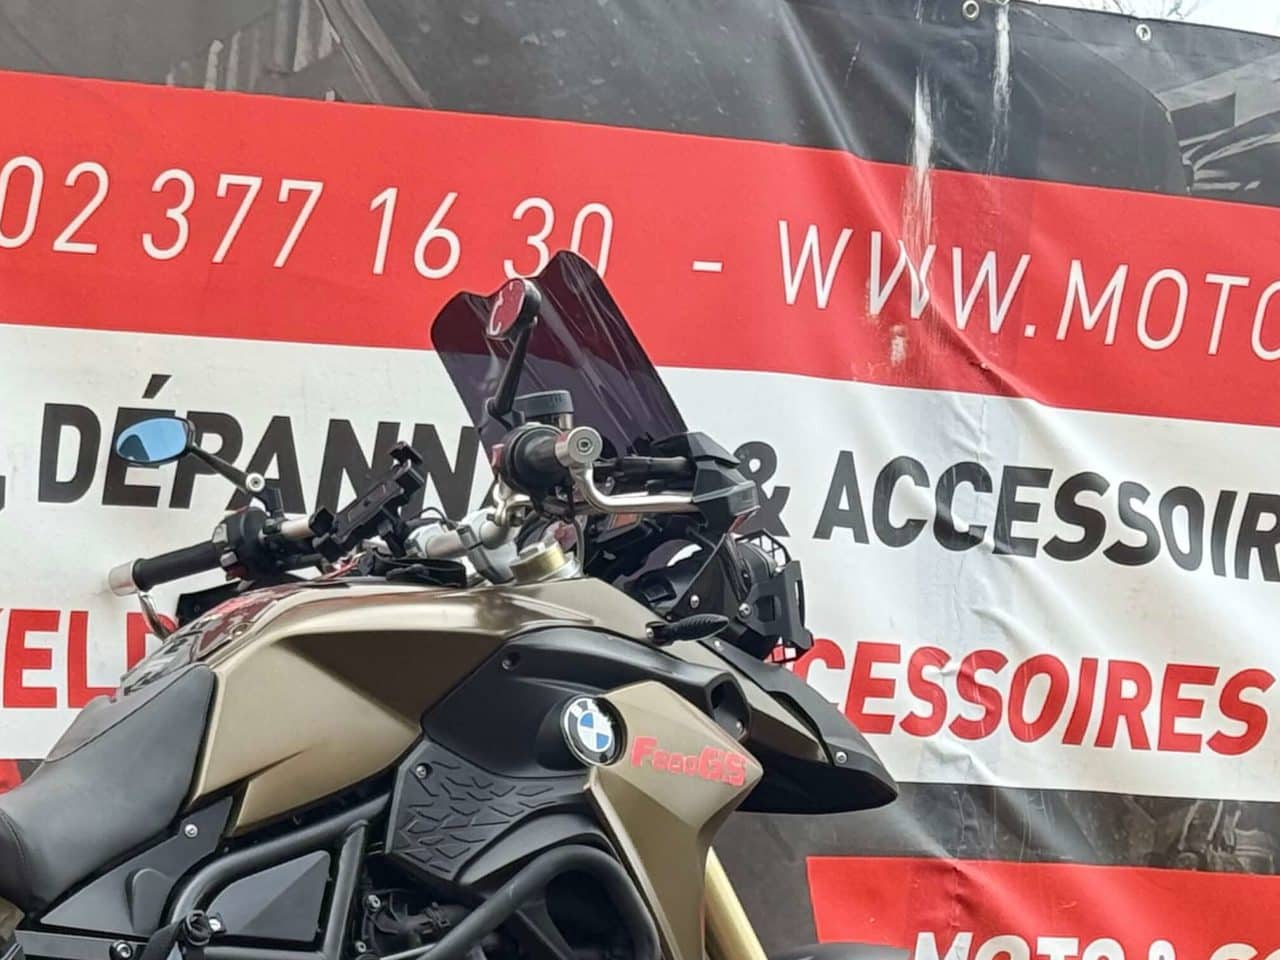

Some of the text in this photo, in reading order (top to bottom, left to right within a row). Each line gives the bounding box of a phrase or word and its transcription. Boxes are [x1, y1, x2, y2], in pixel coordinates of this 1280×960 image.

[142, 169, 324, 267] 377
[368, 188, 460, 279] 16
[504, 198, 614, 279] 30
[37, 374, 494, 521] DÉPANN
